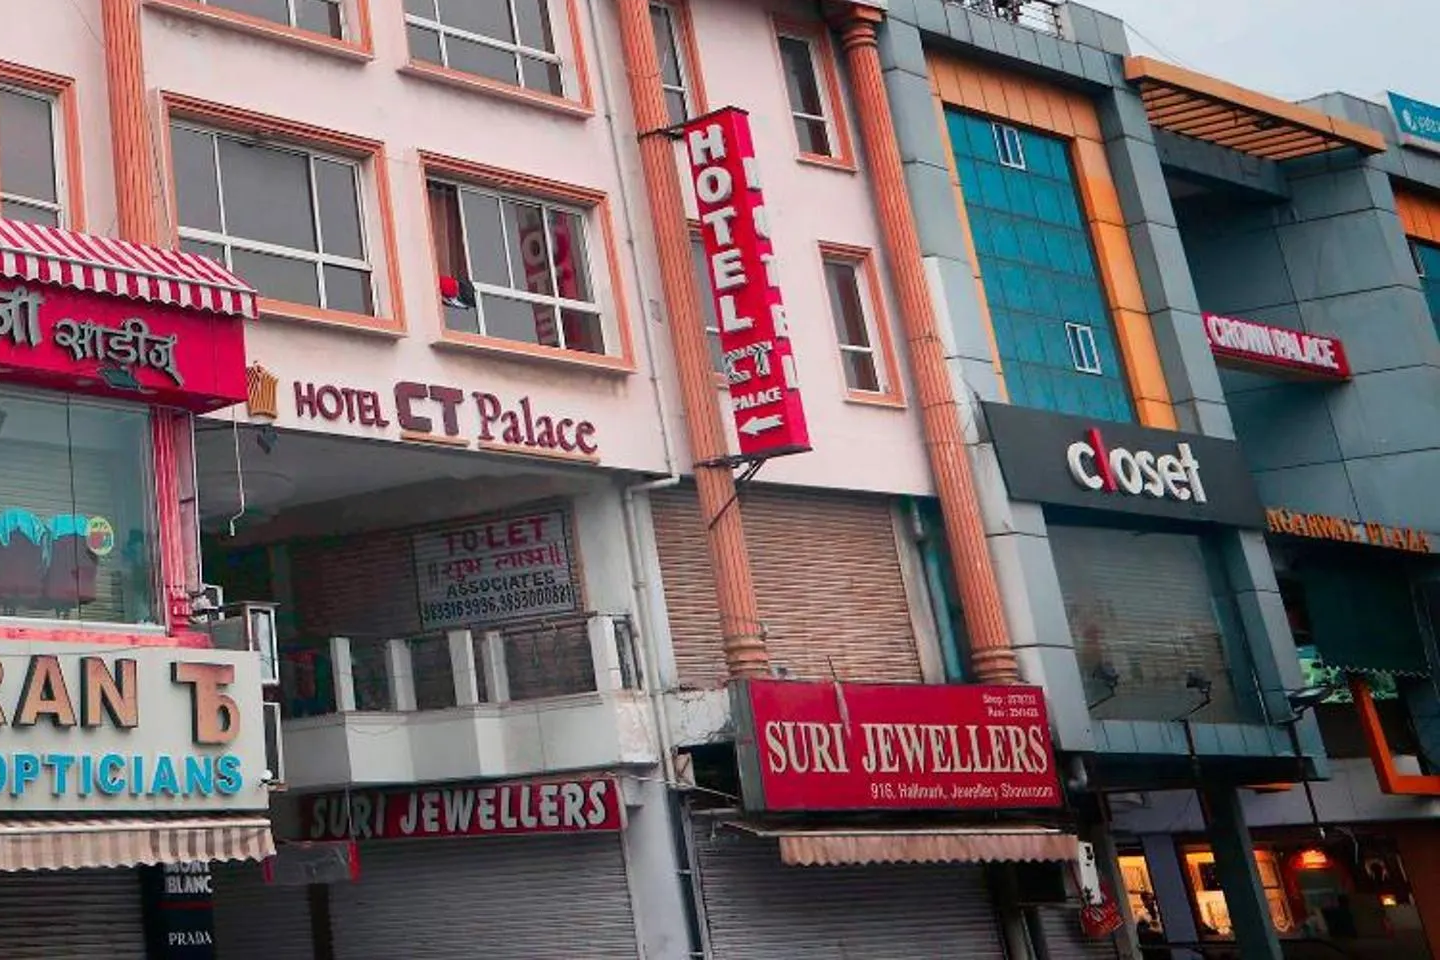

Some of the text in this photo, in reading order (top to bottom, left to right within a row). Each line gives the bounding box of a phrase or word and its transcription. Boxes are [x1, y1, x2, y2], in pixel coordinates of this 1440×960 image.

[688, 123, 755, 333] HOTEL
[723, 341, 773, 384] CT
[293, 381, 598, 454] HOTEL CT Palace
[732, 388, 782, 411] PALACE
[1067, 427, 1207, 504] closet
[447, 570, 556, 599] ASSOCIATES
[765, 720, 1049, 775] SURI JEWELLERS
[311, 780, 608, 840] SURI JEWELLERS
[166, 875, 213, 894] BLANC
[168, 931, 213, 946] PRADA
